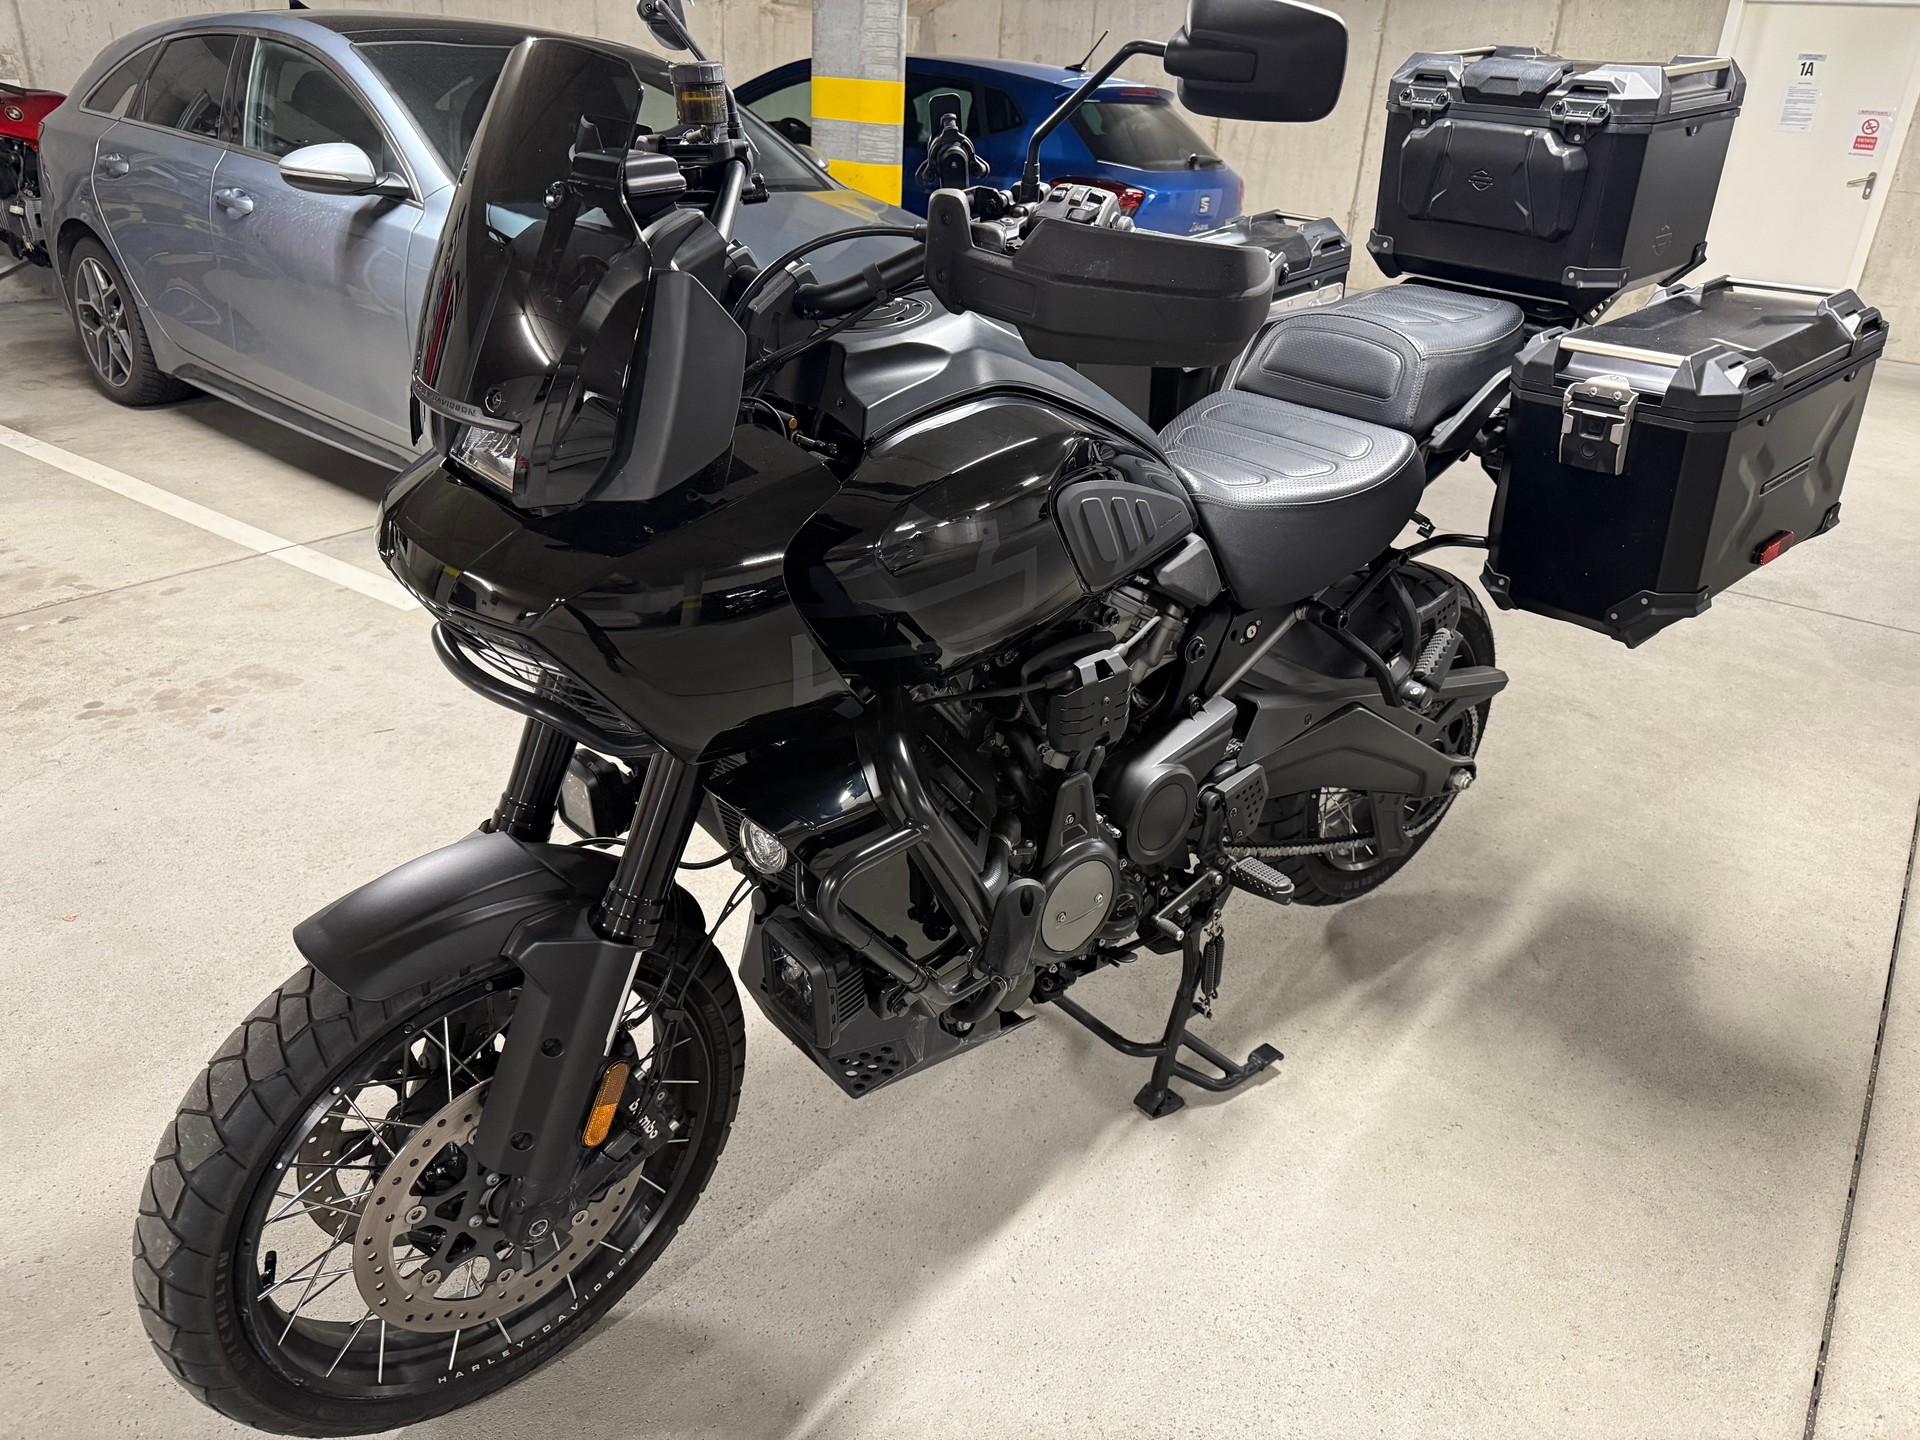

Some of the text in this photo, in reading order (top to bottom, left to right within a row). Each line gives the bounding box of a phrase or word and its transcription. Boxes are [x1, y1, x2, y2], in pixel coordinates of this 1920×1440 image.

[1800, 61, 1814, 76] 1A
[628, 1097, 659, 1139] brmbo
[437, 1244, 639, 1384] HARLEY-DAVIDSON
